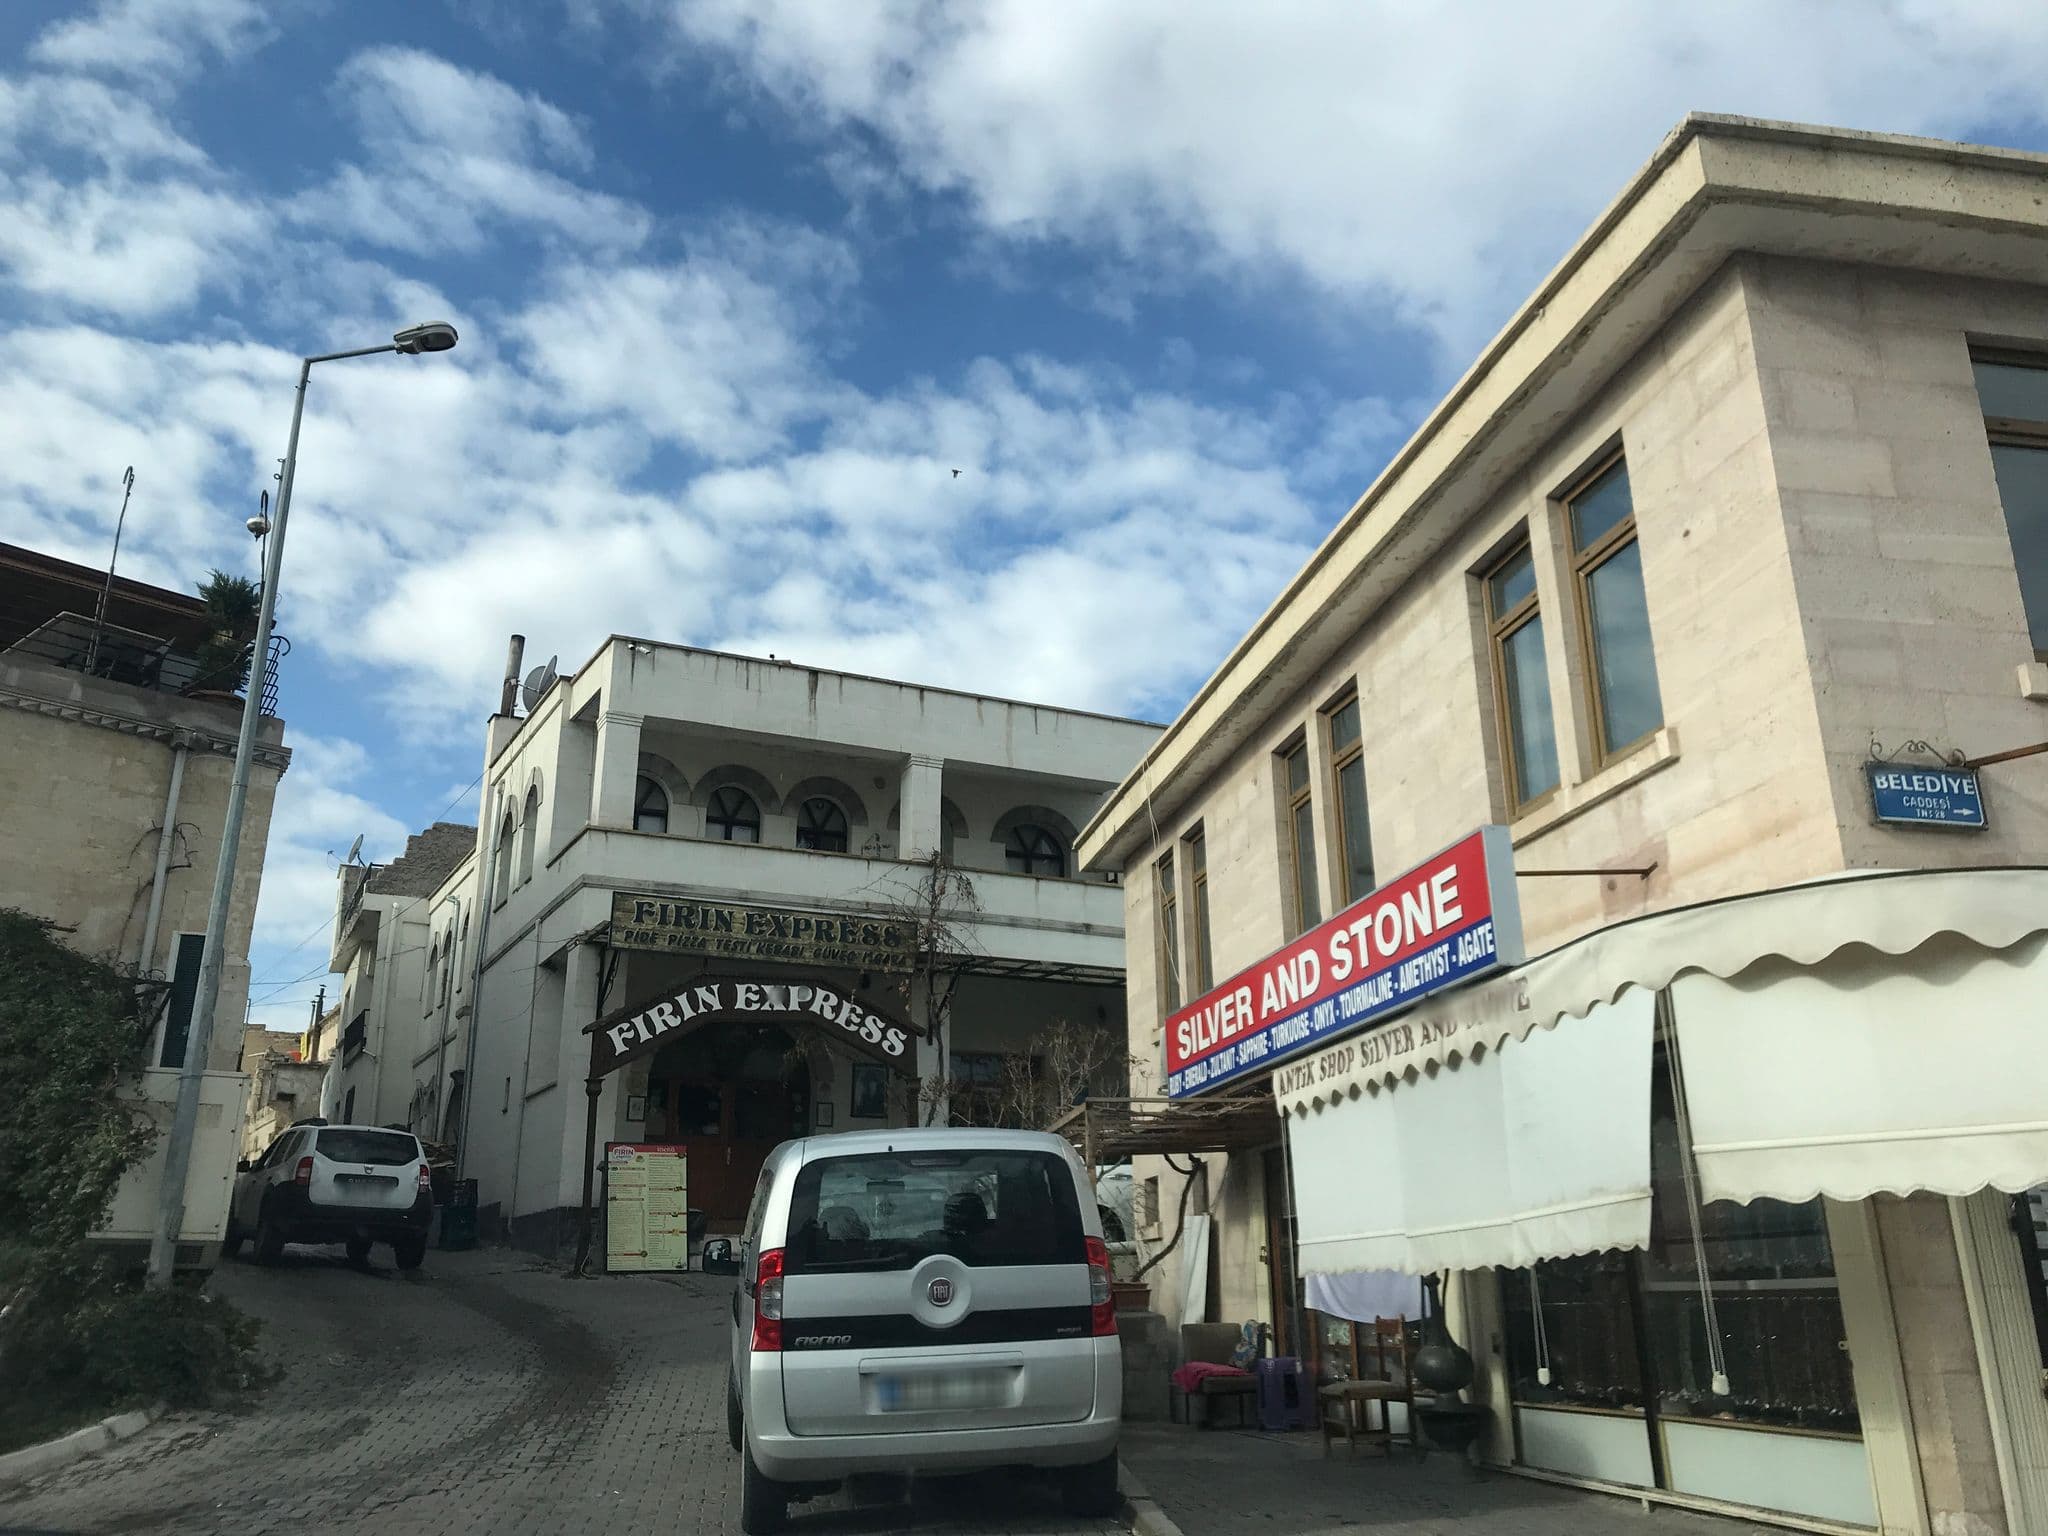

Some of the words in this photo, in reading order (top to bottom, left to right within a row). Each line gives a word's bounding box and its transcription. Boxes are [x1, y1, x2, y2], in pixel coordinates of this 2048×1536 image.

[632, 900, 734, 933] FIRIN
[744, 911, 900, 948] EXPRESS
[1178, 985, 1254, 1060] SILVER
[1262, 949, 1321, 1019] AND
[1329, 863, 1464, 981] STONE
[606, 984, 723, 1056] FIRIN
[735, 984, 908, 1056] EXPRESS
[1239, 1032, 1268, 1066] SAPPHIRE
[1314, 999, 1336, 1031] ONYX
[1340, 971, 1393, 1020] TOURMALINE
[1400, 943, 1450, 993] AMETHYST
[1458, 922, 1494, 967] AGATE
[1320, 1046, 1354, 1081] SHOP
[934, 1285, 948, 1299] FIAT
